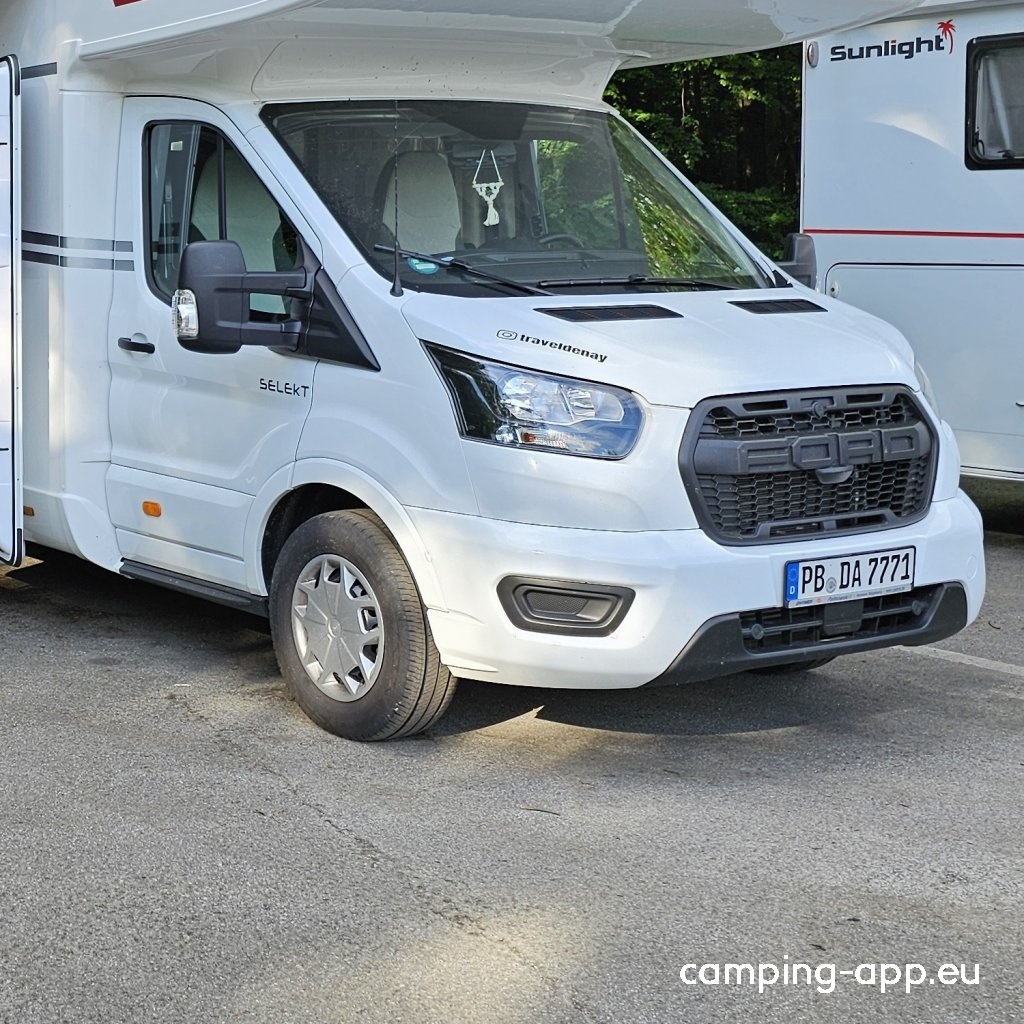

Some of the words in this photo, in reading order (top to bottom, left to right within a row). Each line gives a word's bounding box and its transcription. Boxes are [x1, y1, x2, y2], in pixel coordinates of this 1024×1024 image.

[830, 34, 945, 62] Sunlight
[519, 334, 608, 363] traveldenay
[259, 377, 310, 398] SELEKT
[801, 564, 825, 594] PB
[838, 559, 862, 590] DA
[868, 552, 911, 586] 7771
[789, 585, 796, 595] D
